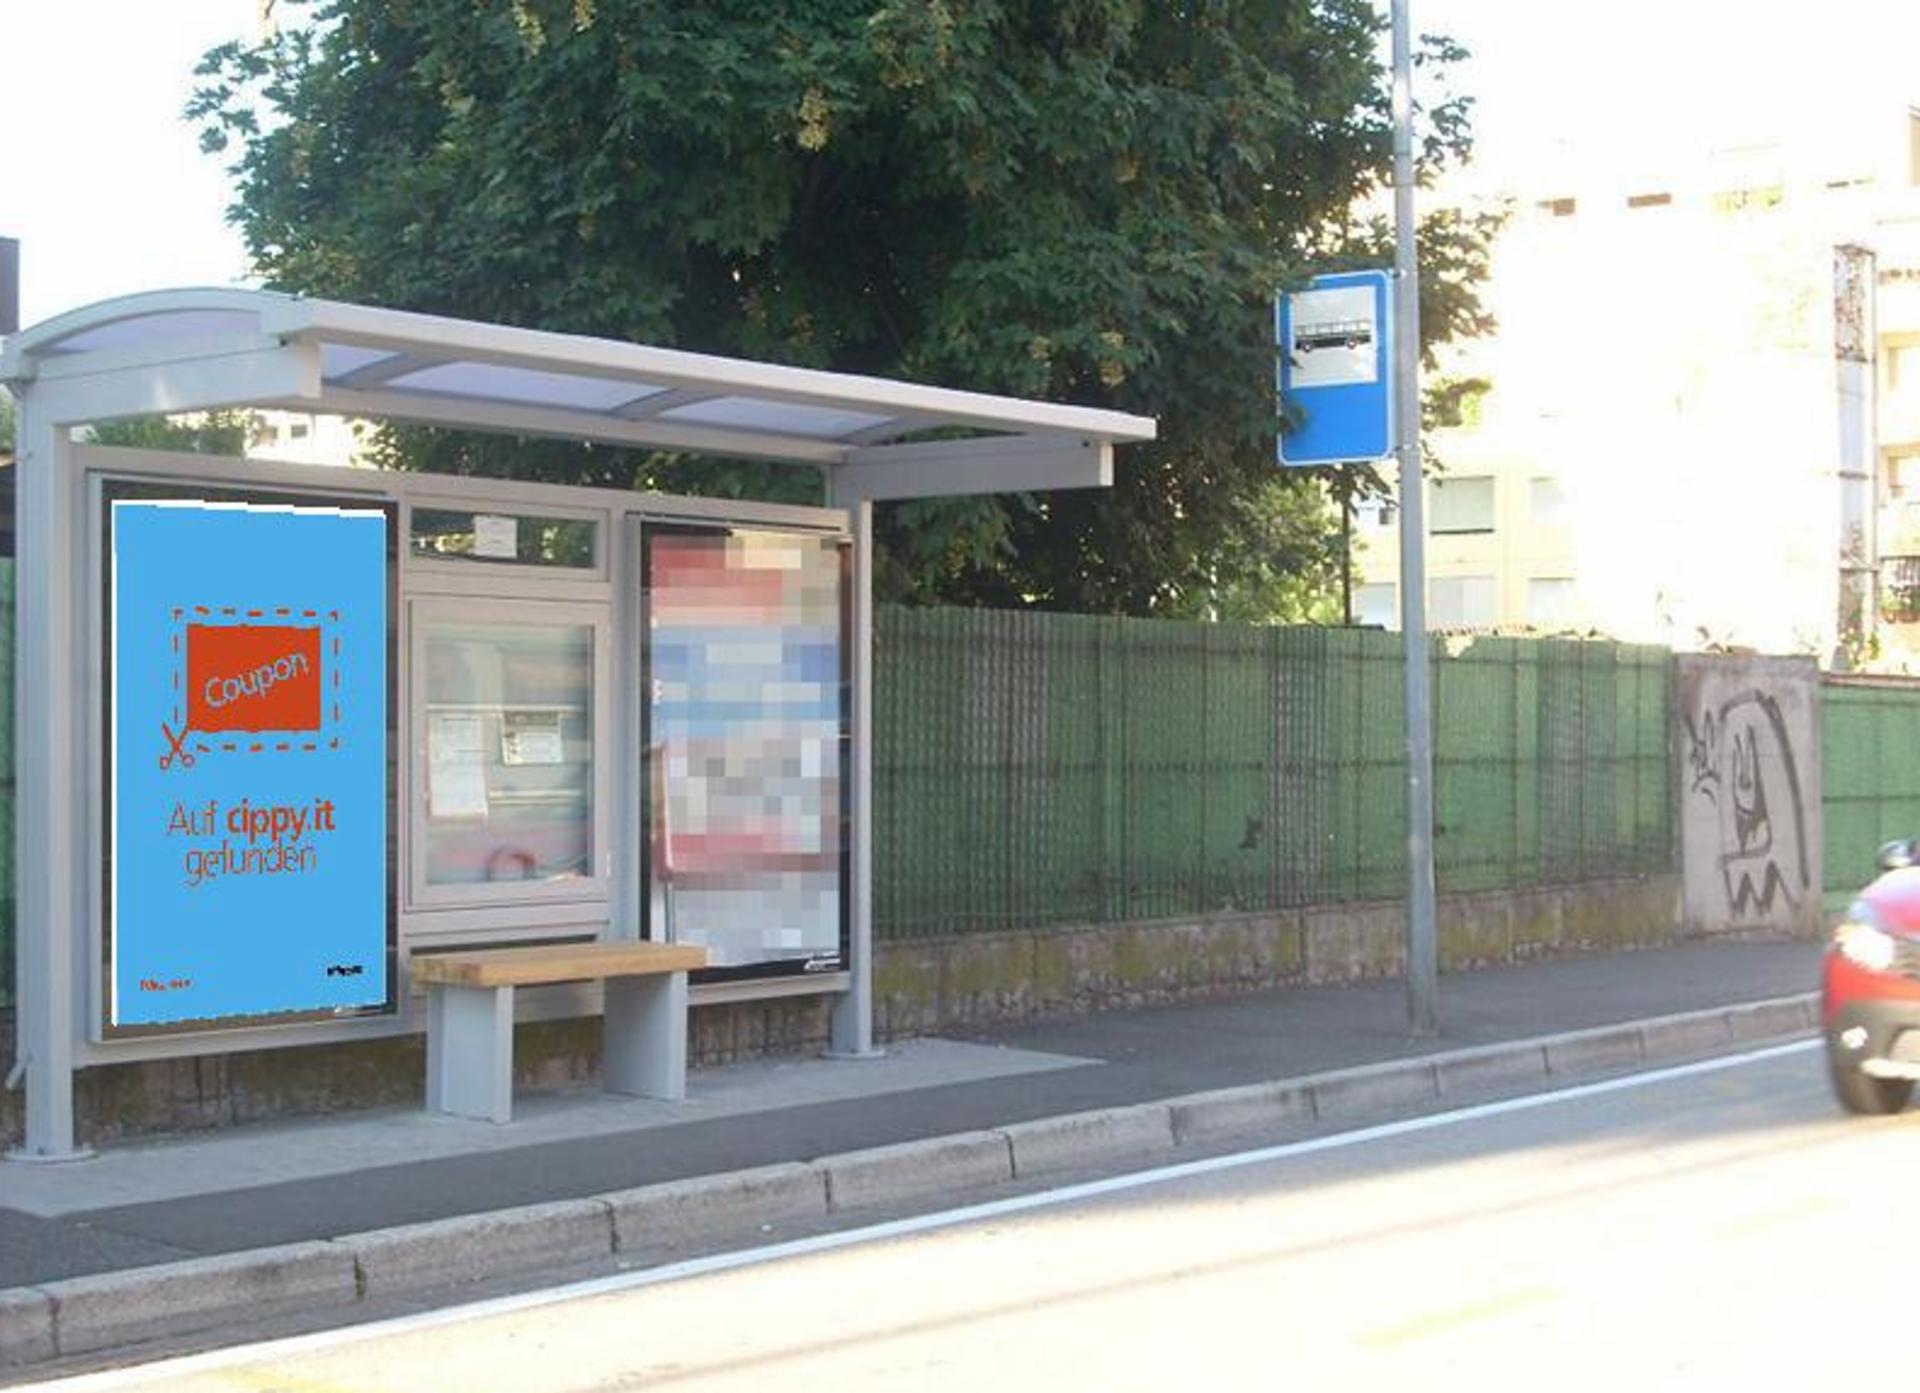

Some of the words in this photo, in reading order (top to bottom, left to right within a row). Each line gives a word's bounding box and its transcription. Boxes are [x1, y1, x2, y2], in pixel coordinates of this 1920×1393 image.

[204, 653, 309, 707] Coupon
[168, 800, 216, 836] Auf
[227, 798, 336, 844] cippy.it
[184, 838, 316, 887] gefunden
